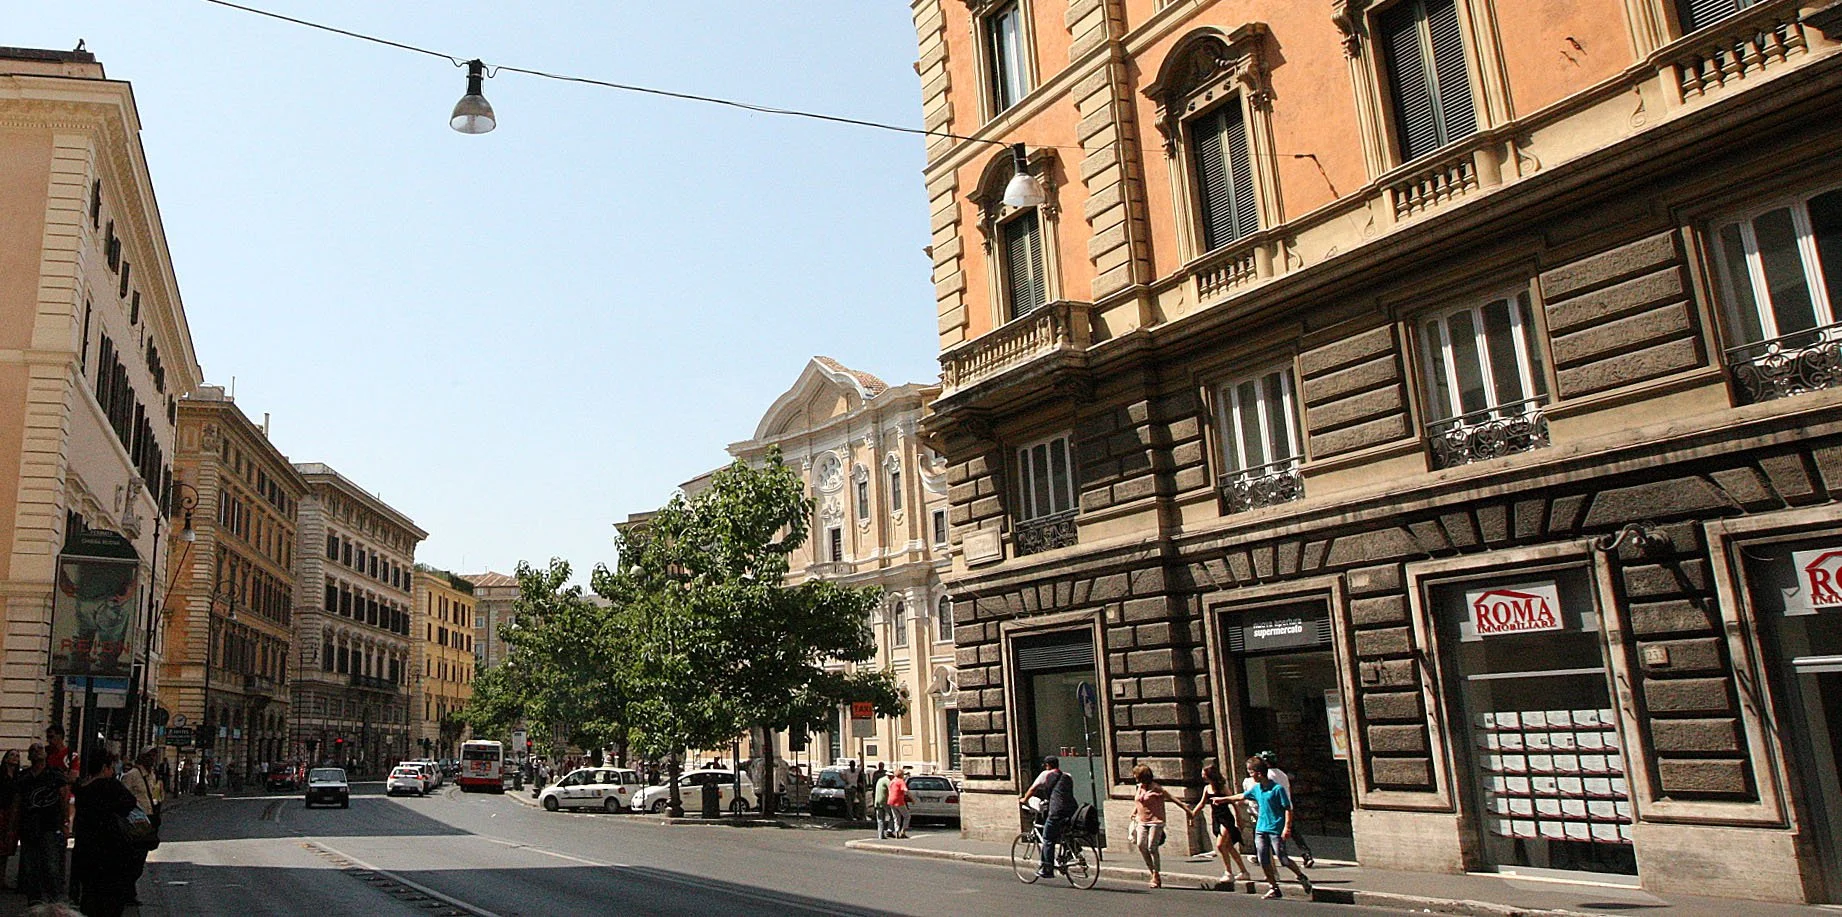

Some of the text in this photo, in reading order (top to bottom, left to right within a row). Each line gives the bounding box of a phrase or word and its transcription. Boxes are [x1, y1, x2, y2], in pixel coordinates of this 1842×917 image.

[1473, 597, 1555, 626] ROMA
[1253, 625, 1302, 639] supermercato
[1477, 618, 1556, 634] IMMOBILIARE
[853, 704, 872, 713] TAXI
